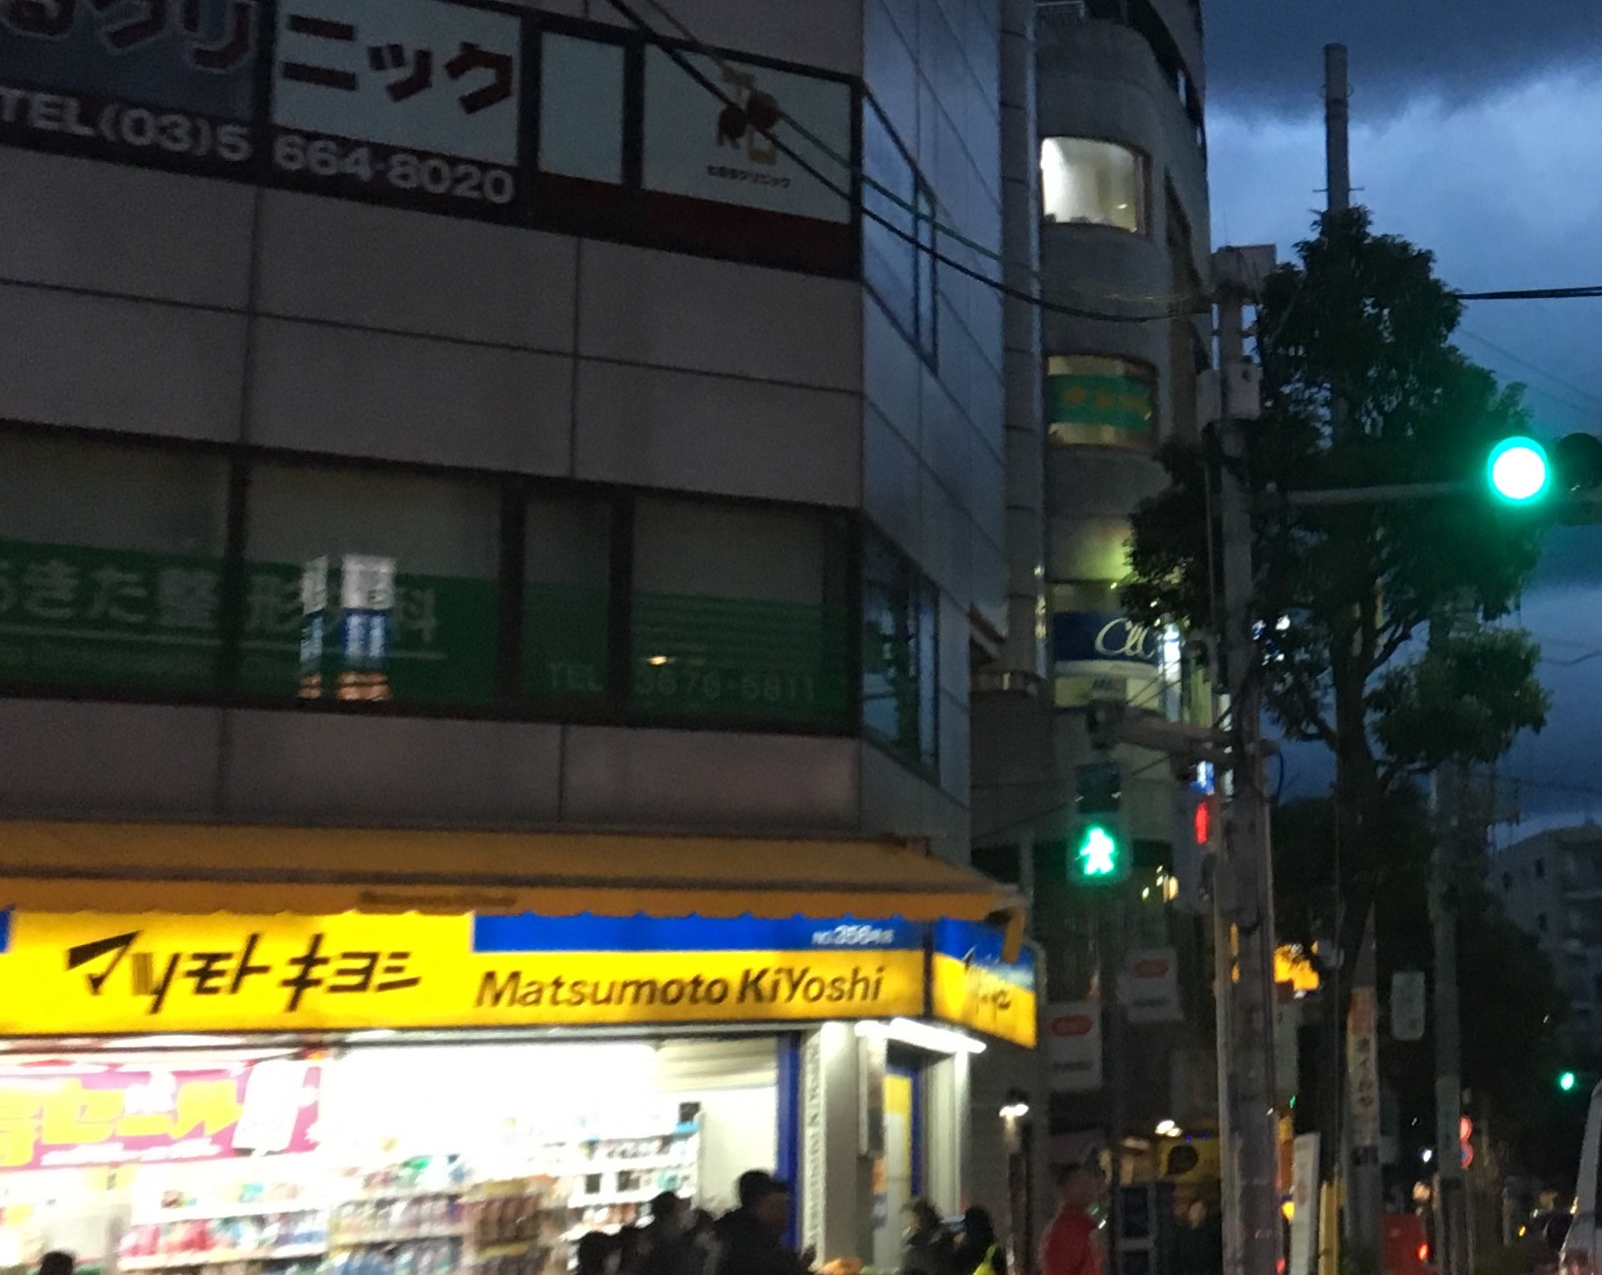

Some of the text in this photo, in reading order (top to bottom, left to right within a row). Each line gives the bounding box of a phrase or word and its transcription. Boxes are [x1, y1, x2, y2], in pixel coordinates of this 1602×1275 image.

[66, 929, 422, 1015] マツモトキヨシ
[475, 966, 886, 1008] Matsumoto KiYoshi
